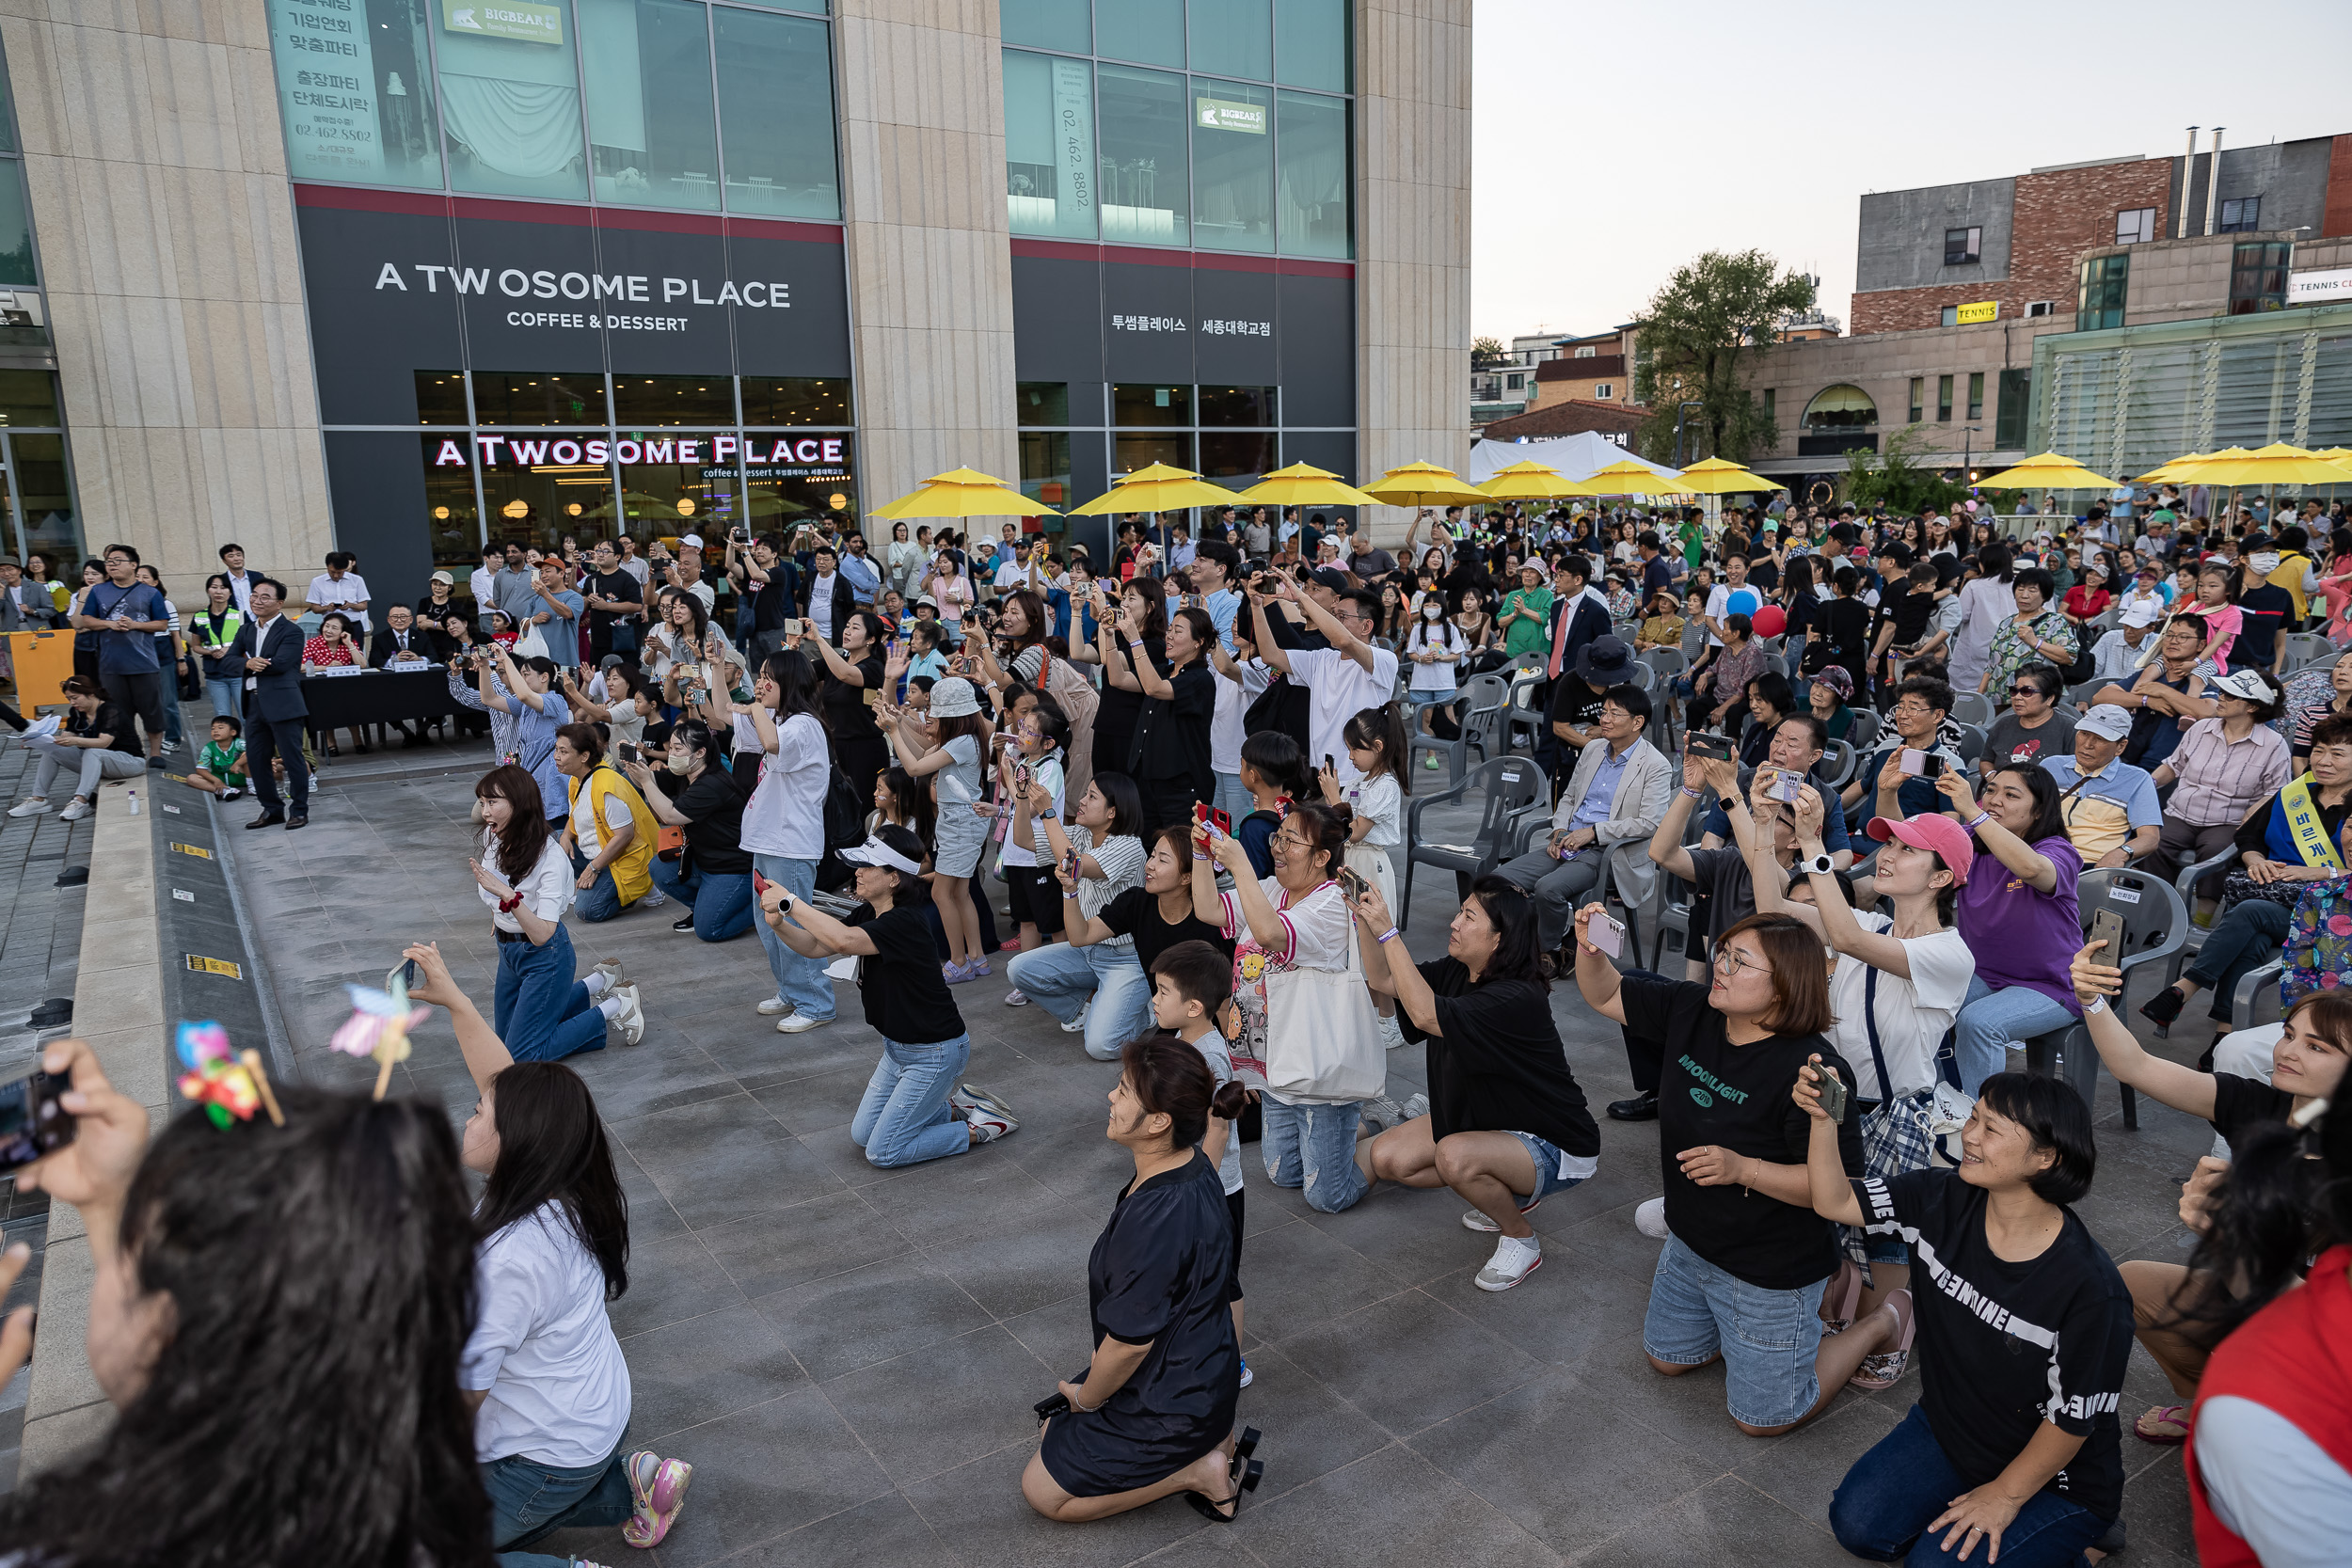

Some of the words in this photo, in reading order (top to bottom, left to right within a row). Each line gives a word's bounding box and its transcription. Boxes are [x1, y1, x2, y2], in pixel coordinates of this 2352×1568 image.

[289, 12, 352, 34] 기업연회
[290, 35, 358, 57] 맞춤파티
[297, 70, 359, 91] 출장파티
[293, 90, 369, 112] 단체도시락
[295, 124, 373, 142] 02.462.8802
[375, 262, 408, 292] A
[415, 264, 650, 301] TWOSOME
[662, 277, 791, 309] PLACE
[2300, 281, 2339, 291] TENNIS
[506, 311, 584, 328] COFFEE
[589, 314, 602, 329] &
[607, 315, 689, 332] DESSERT
[1960, 307, 1995, 319] TENNIS
[1111, 314, 1186, 332] 투썸플레이스
[1201, 319, 1271, 337] 세종대학교점
[436, 439, 466, 466] A
[476, 436, 700, 465] TWOSOME
[712, 436, 843, 464] PLACE
[704, 468, 732, 478] coffee
[746, 468, 772, 477] essert
[1677, 1053, 1749, 1105] MOONLIGHT
